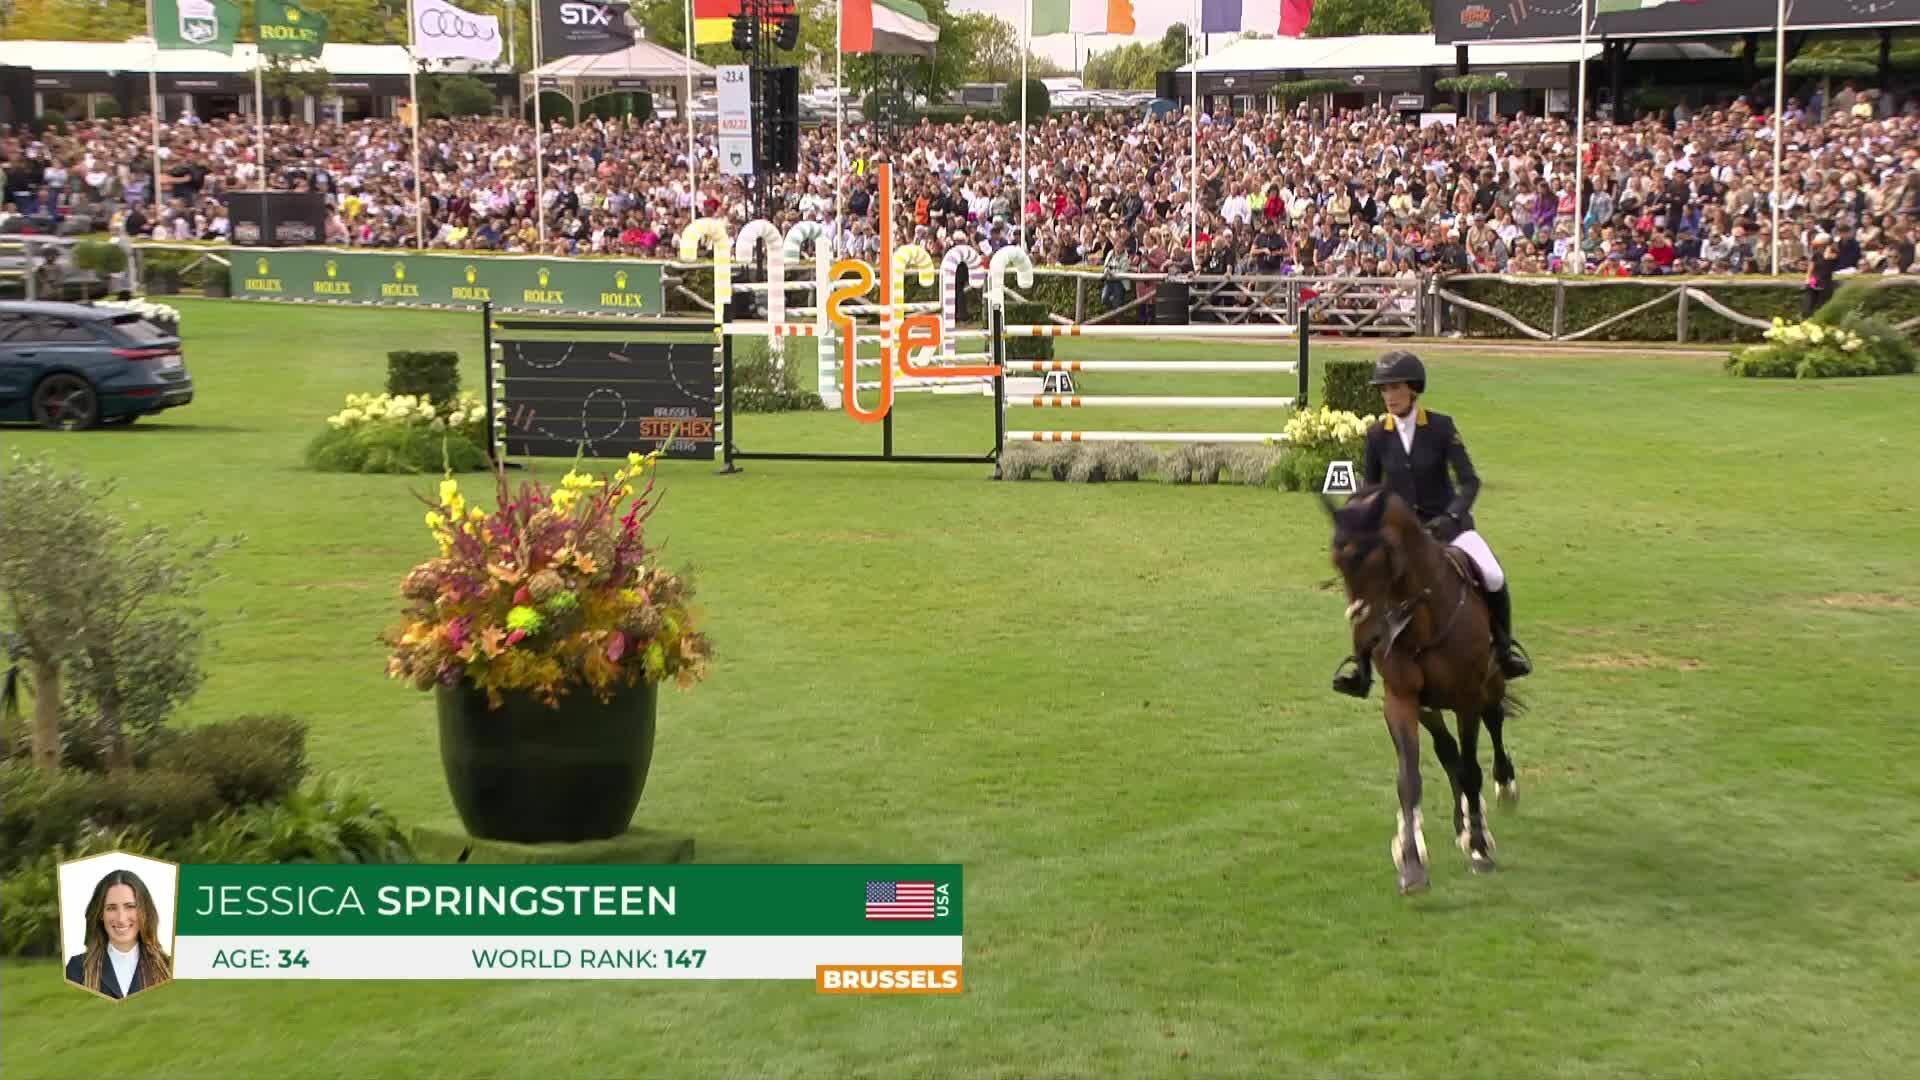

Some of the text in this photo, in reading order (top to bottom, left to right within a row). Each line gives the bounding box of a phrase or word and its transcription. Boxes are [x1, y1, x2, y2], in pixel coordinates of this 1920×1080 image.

[560, 3, 609, 25] STX
[452, 287, 490, 301] ROLEX
[524, 289, 564, 304] ROLEX
[601, 292, 642, 307] ROLEX
[653, 406, 698, 417] BRUSSELS
[1331, 470, 1349, 487] 15
